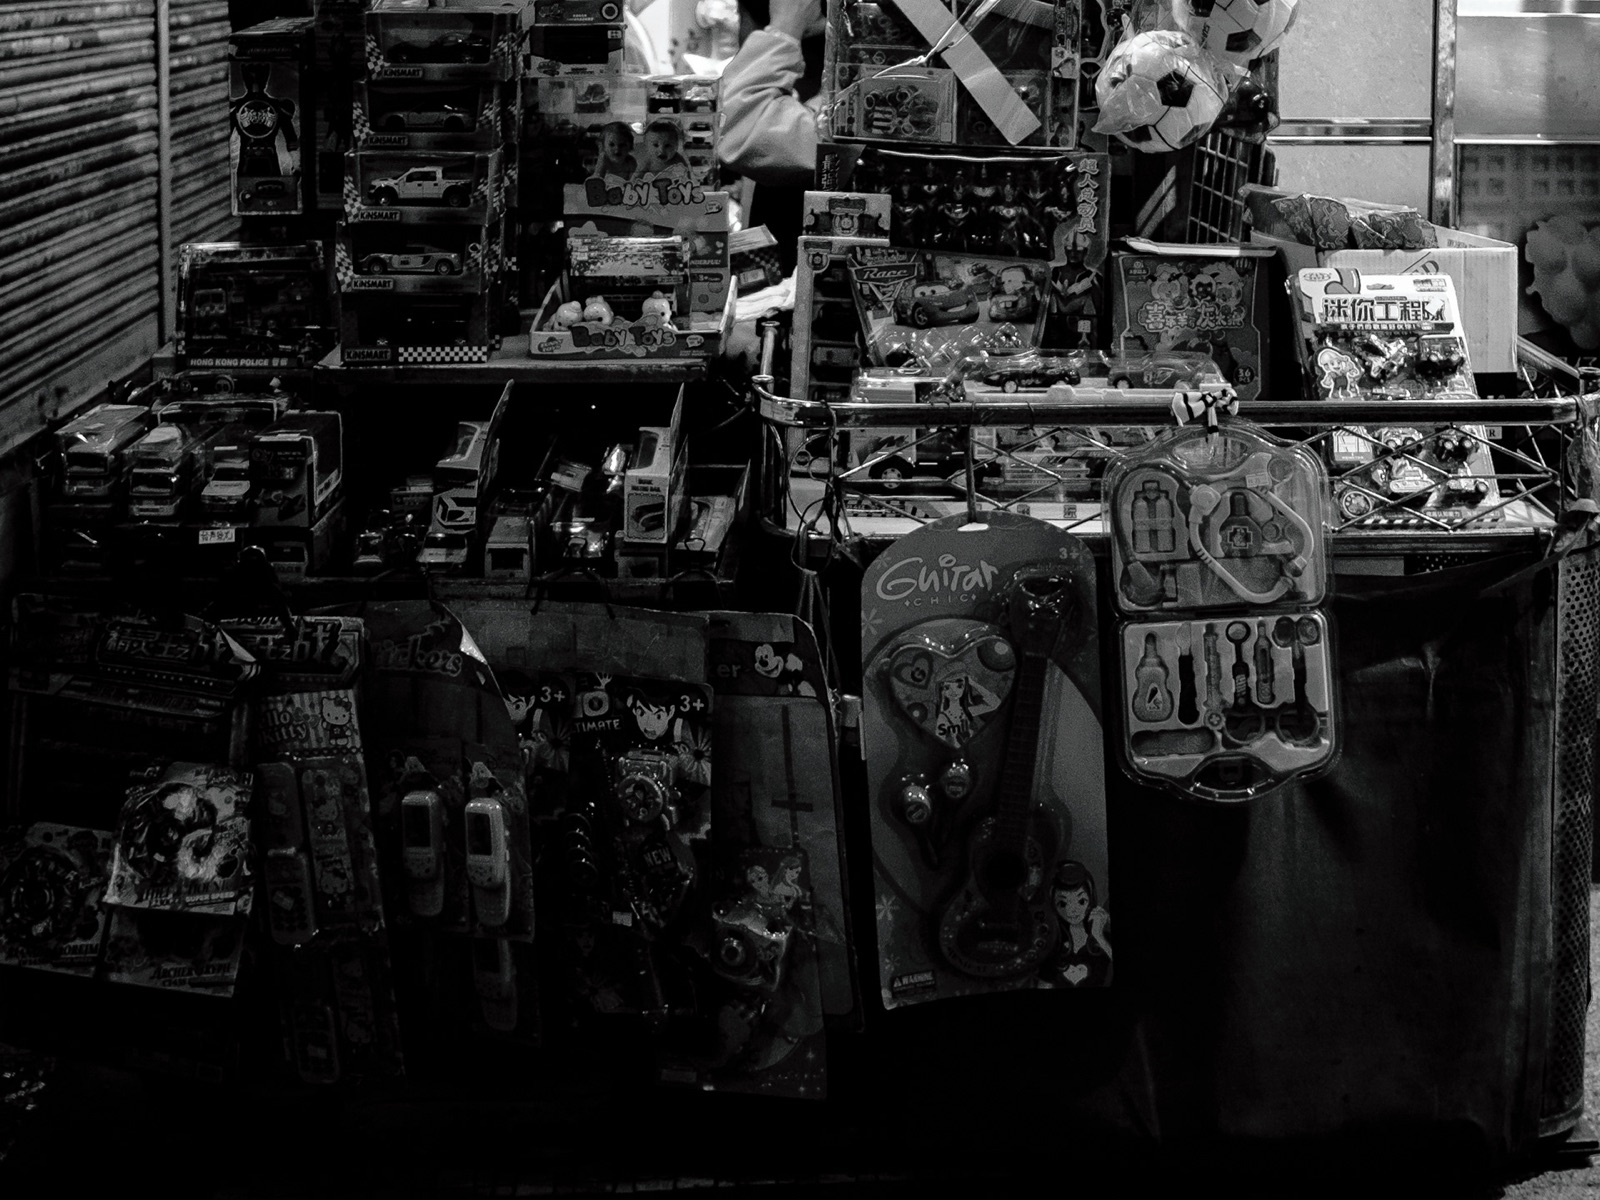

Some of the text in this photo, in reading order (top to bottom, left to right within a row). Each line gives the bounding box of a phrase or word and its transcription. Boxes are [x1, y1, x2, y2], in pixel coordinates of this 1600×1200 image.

[190, 358, 214, 367] HONG
[215, 358, 239, 367] KONG
[240, 358, 269, 367] POLICE
[540, 686, 566, 703] 3+
[679, 695, 705, 712] 3+
[575, 718, 621, 734] TIMATE
[643, 848, 672, 867] NEW
